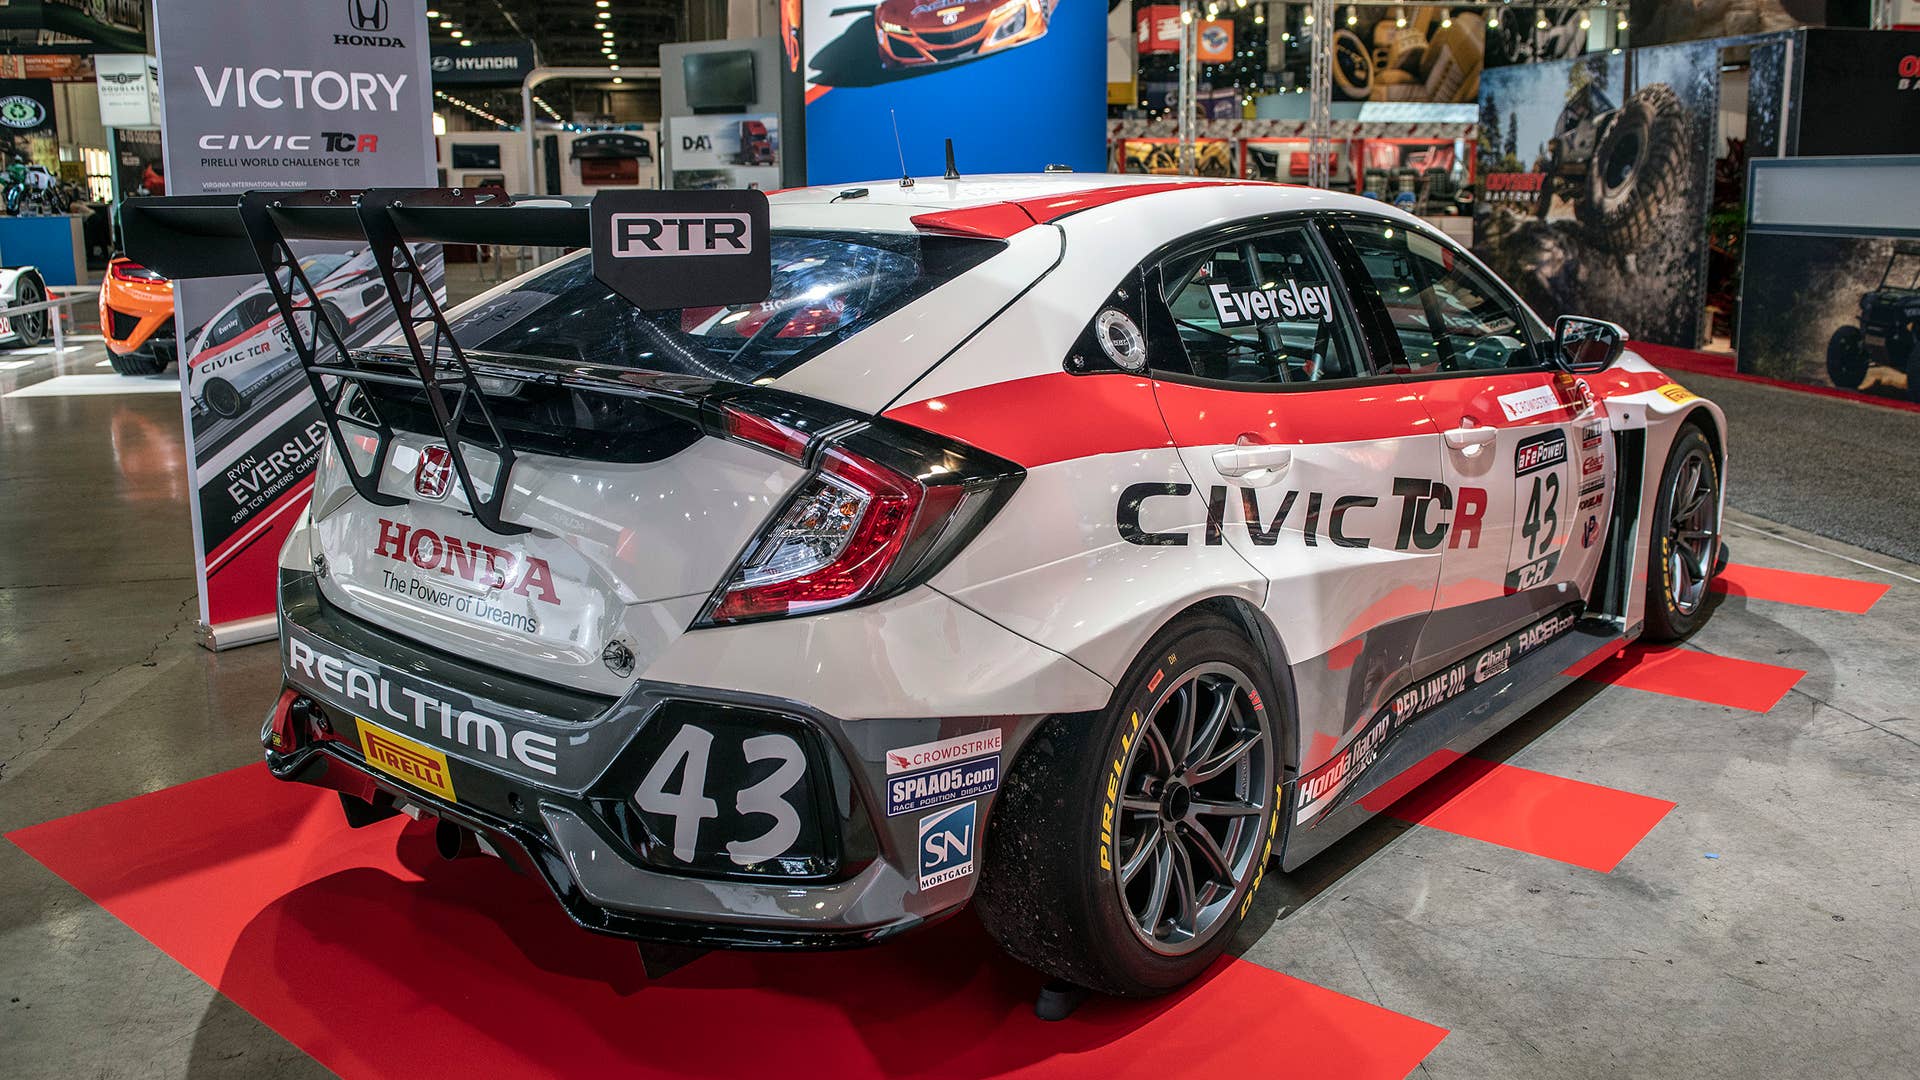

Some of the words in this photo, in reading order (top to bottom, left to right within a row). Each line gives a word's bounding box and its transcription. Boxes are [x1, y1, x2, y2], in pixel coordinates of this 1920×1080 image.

[333, 34, 406, 49] HONDA
[456, 57, 518, 70] HYUNDAI
[194, 65, 408, 112] VICTORY
[198, 134, 312, 151] CIVIC
[321, 132, 379, 153] TCR
[201, 158, 238, 168] PIRELLI
[240, 158, 280, 168] WORLD
[282, 158, 340, 168] CHALLENGE
[342, 158, 361, 168] TCR
[1486, 172, 1547, 190] ODYSSEY
[201, 181, 231, 189] VIRGINIA
[1485, 191, 1541, 202] BATTERY
[617, 218, 748, 252] RTR
[1209, 278, 1334, 324] Eversley
[201, 351, 246, 374] CIVIC
[247, 342, 271, 358] TCR
[226, 455, 257, 482] RYAN
[231, 507, 250, 524] 2018
[247, 495, 266, 510] TCR
[263, 471, 296, 499] DRIVERS'
[1115, 482, 1379, 550] CIVIC
[1391, 477, 1488, 550] TCR
[1521, 472, 1560, 561] 43
[374, 518, 561, 606] HONDA
[1517, 560, 1549, 591] TCR
[383, 569, 406, 594] The
[409, 577, 454, 608] Power
[456, 590, 471, 613] of
[476, 596, 537, 633] Dreams
[1518, 615, 1575, 654] RACER.com
[289, 636, 558, 776] REALTIME
[1394, 690, 1419, 728] RED
[1416, 673, 1448, 713] LINE
[1447, 664, 1466, 698] OIL
[364, 730, 445, 789] PIRELLI
[913, 736, 1001, 765] CROWDSTRIKE
[1297, 750, 1352, 808] Honda
[1351, 714, 1390, 767] Racing
[634, 723, 807, 866] 43
[893, 801, 915, 812] RACE
[920, 792, 956, 806] POSITION
[961, 783, 993, 796] DISPLAY
[1100, 711, 1138, 872] PIRELLI
[924, 824, 970, 868] SN
[921, 864, 973, 889] MORTGAGE
